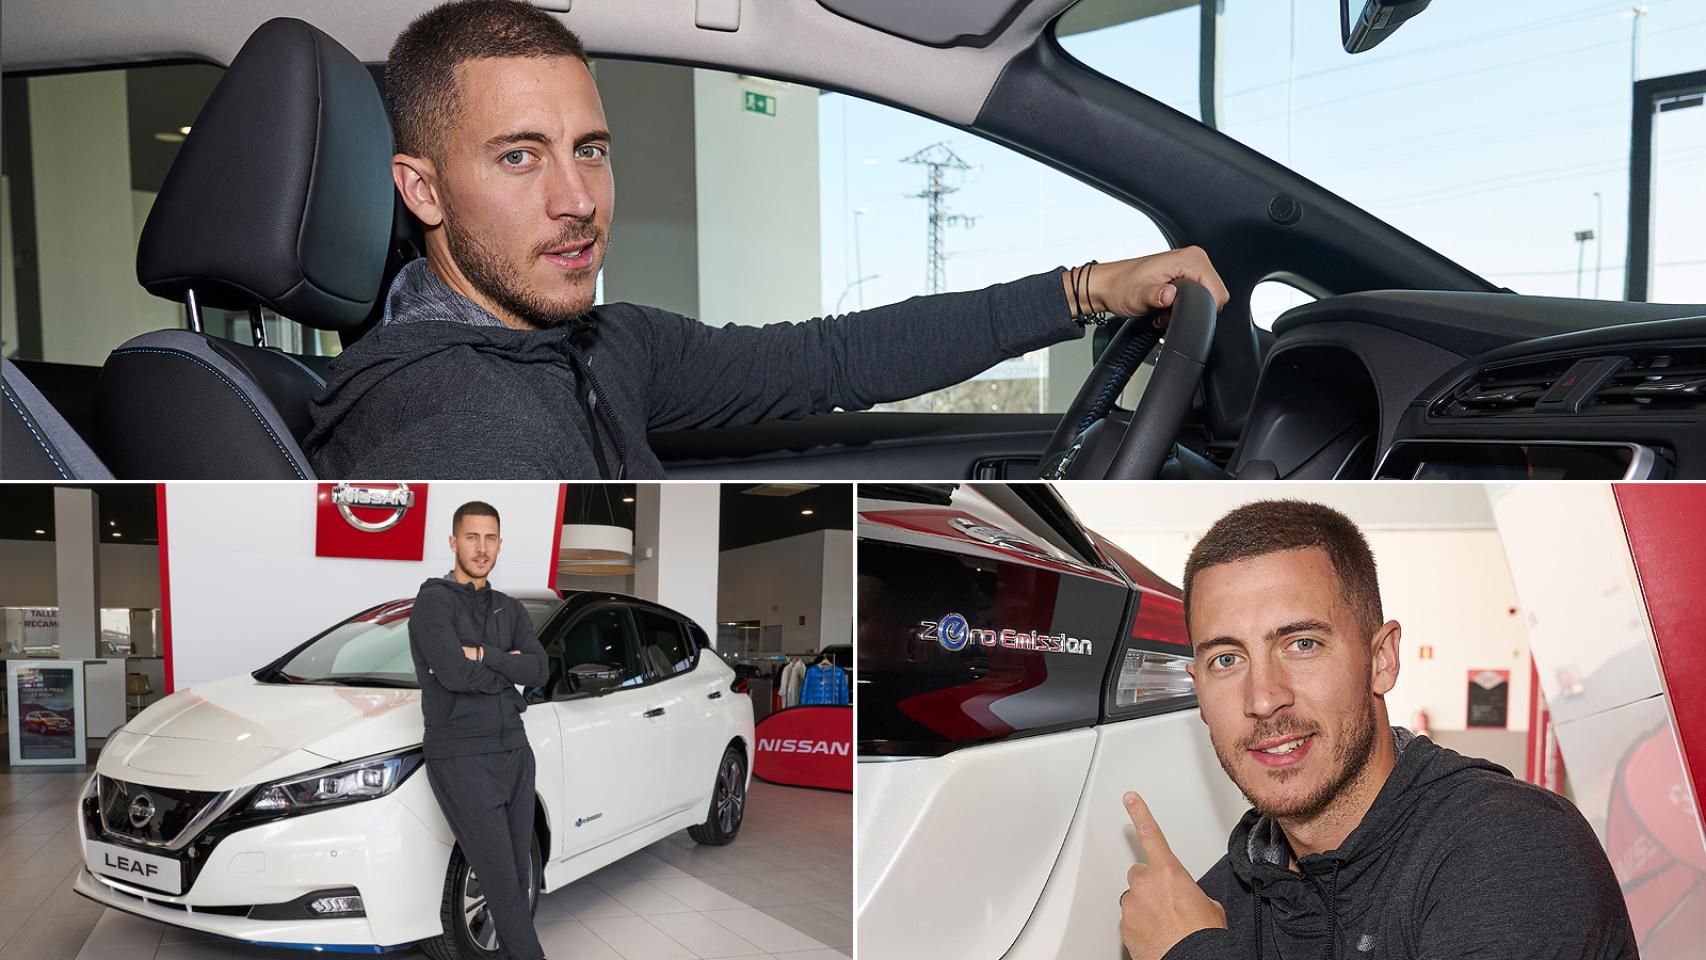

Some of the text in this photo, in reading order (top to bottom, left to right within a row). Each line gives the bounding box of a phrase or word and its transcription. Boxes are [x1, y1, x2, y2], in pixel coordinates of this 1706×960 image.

[343, 488, 408, 505] NISSAN
[1001, 628, 1093, 656] Emission
[757, 738, 851, 757] NISSAN
[104, 852, 159, 877] LEAF
